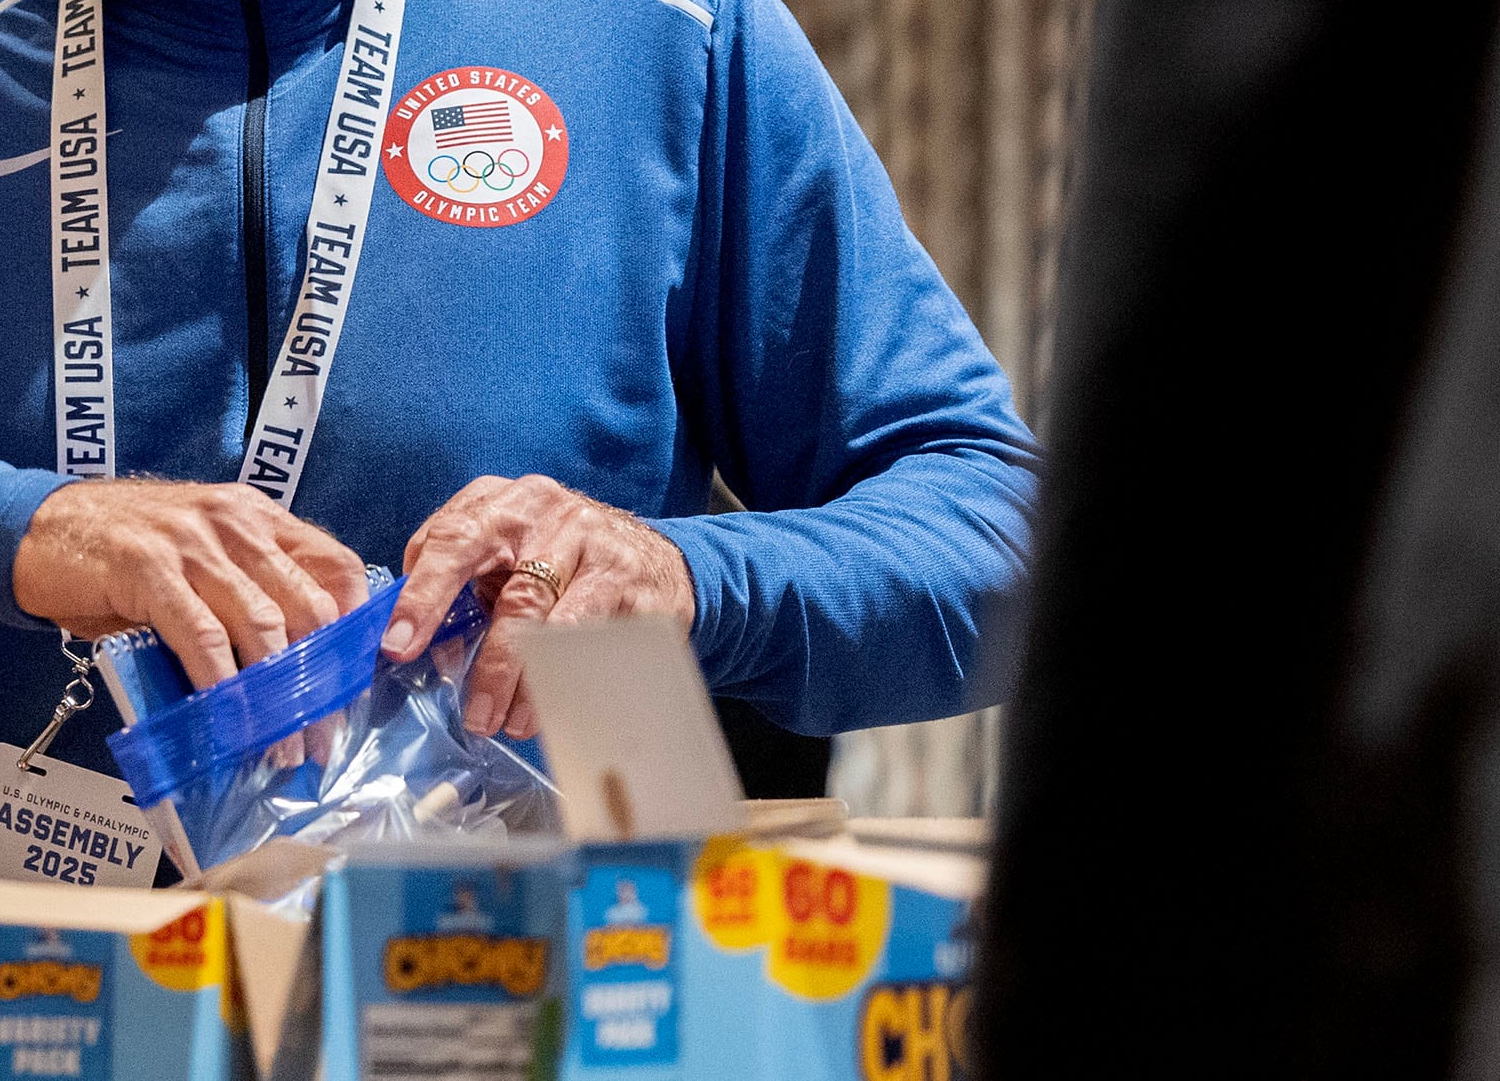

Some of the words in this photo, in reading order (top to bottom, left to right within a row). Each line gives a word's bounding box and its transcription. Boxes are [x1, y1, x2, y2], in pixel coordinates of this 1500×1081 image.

[343, 24, 393, 110] TEAM
[396, 73, 461, 121] UNITED
[469, 70, 542, 107] STATES
[59, 112, 99, 181] USA
[327, 111, 377, 177] USA
[61, 188, 101, 273] TEAM
[413, 190, 500, 222] OLYMPIC
[506, 181, 552, 219] TEAM
[304, 221, 357, 306] TEAM
[63, 315, 104, 384] USA
[281, 312, 334, 377] USA
[246, 424, 305, 503] TEA
[3, 785, 23, 800] U.S.
[26, 792, 71, 815] OLYMPIC
[74, 807, 81, 818] &
[83, 811, 150, 840] PARALYMPIC
[23, 844, 99, 887] 2025
